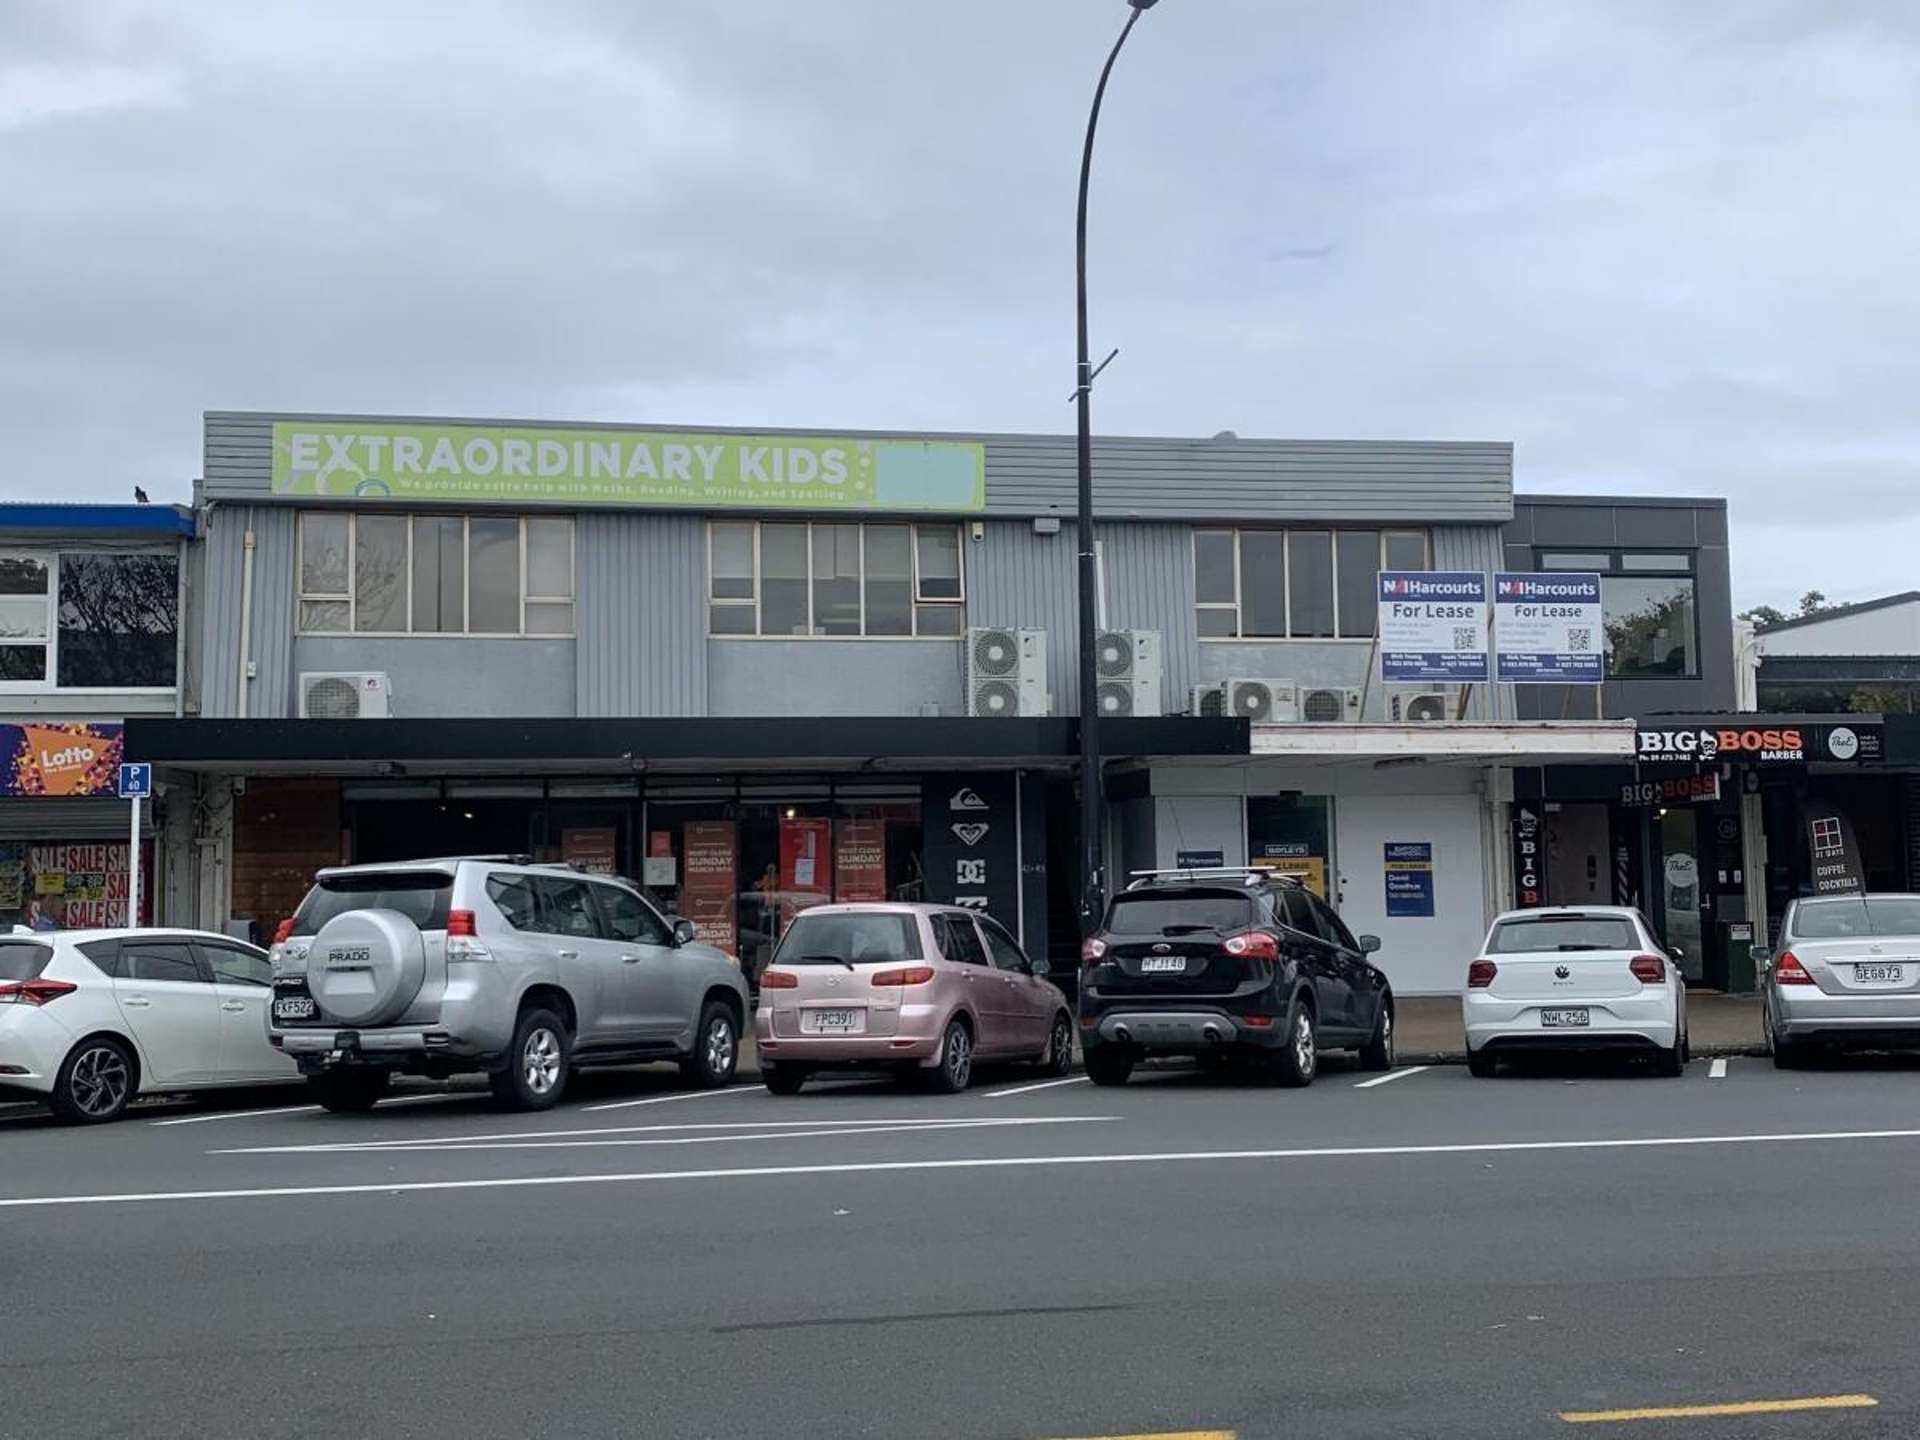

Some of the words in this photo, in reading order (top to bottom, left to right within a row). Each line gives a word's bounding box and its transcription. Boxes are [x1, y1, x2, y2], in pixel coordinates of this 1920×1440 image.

[291, 433, 724, 481] EXTRAORDINARY
[739, 446, 848, 485] KIDS
[1409, 580, 1481, 595] Harcourts
[1525, 581, 1596, 596] Harcourts
[1393, 603, 1422, 618] For
[1426, 603, 1475, 619] Lease
[1514, 604, 1538, 618] For
[1541, 604, 1583, 618] Lease
[1638, 731, 1698, 751] BIG
[1716, 730, 1803, 751] BOSS
[41, 746, 94, 768] Lotto
[1760, 750, 1804, 760] BARBER
[130, 766, 140, 779] P
[1621, 783, 1654, 802] BIG
[1664, 775, 1714, 798] BOSS
[31, 846, 65, 873] SALE
[68, 846, 105, 873] SALE
[688, 857, 733, 866] SUNDAY
[838, 854, 881, 864] SUNDAY
[69, 901, 105, 928] SALE
[328, 951, 370, 961] PRADO
[815, 1012, 853, 1025] FPC391
[1543, 1011, 1587, 1024] NWL256
